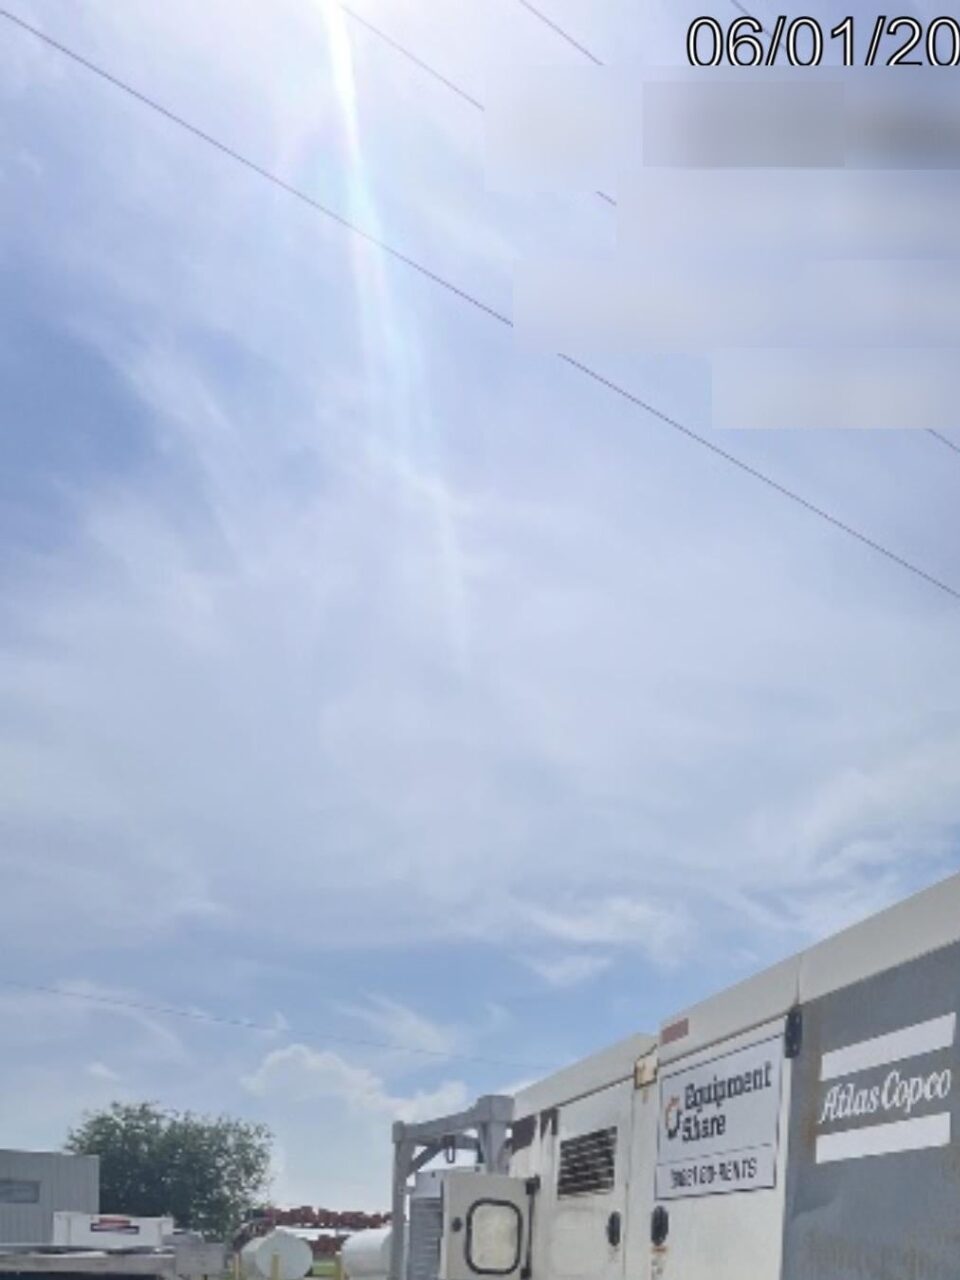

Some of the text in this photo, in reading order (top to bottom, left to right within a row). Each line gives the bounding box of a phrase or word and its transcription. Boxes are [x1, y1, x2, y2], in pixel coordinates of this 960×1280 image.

[684, 1061, 771, 1113] Equipment
[818, 1069, 951, 1124] Atlas Copco
[682, 1114, 726, 1143] Share
